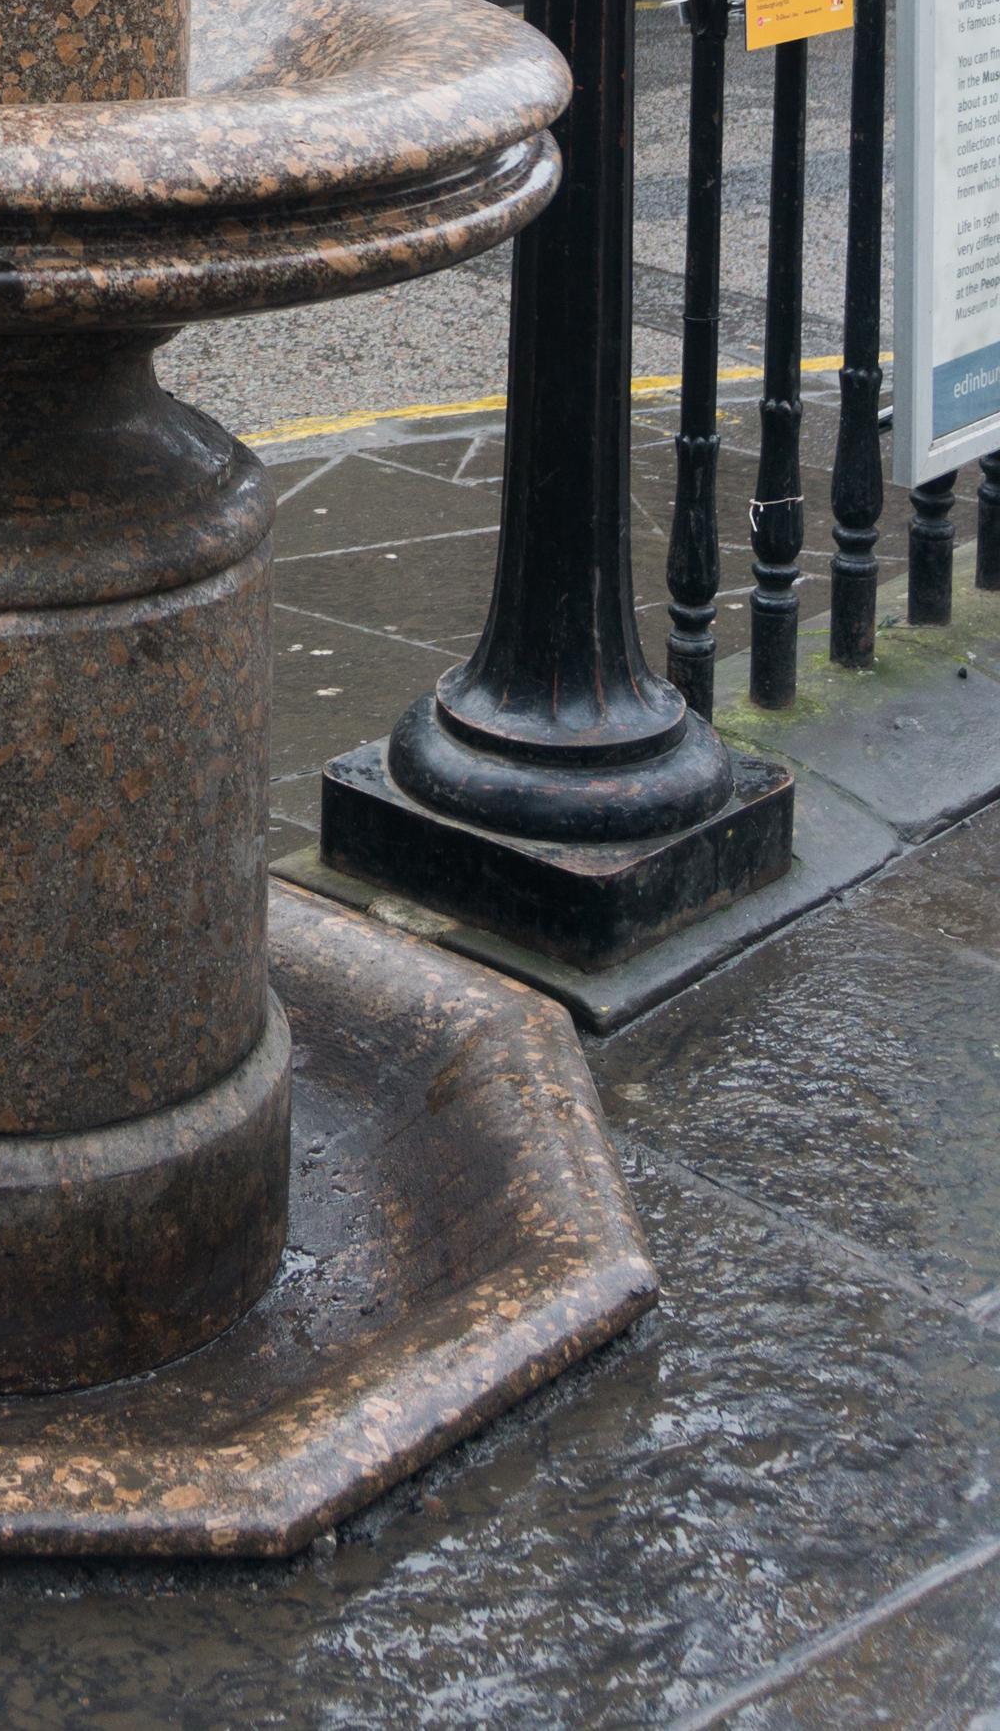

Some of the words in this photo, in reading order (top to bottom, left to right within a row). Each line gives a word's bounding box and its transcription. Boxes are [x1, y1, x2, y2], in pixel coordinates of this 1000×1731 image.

[958, 18, 965, 33] is
[967, 14, 996, 30] famous
[958, 55, 972, 68] You
[974, 52, 988, 65] can
[958, 77, 966, 90] in
[968, 73, 980, 88] the
[958, 96, 980, 113] about
[982, 95, 988, 106] a
[957, 117, 973, 134] find
[974, 115, 987, 129] his
[957, 136, 996, 156] collection
[957, 162, 978, 178] come
[980, 157, 997, 171] face
[957, 186, 976, 199] from
[957, 219, 972, 235] Life
[974, 216, 981, 229] in
[957, 242, 974, 257] very
[956, 256, 985, 279] around
[955, 286, 964, 301] at
[965, 281, 979, 297] the
[955, 300, 988, 322] Museum
[989, 293, 999, 309] of
